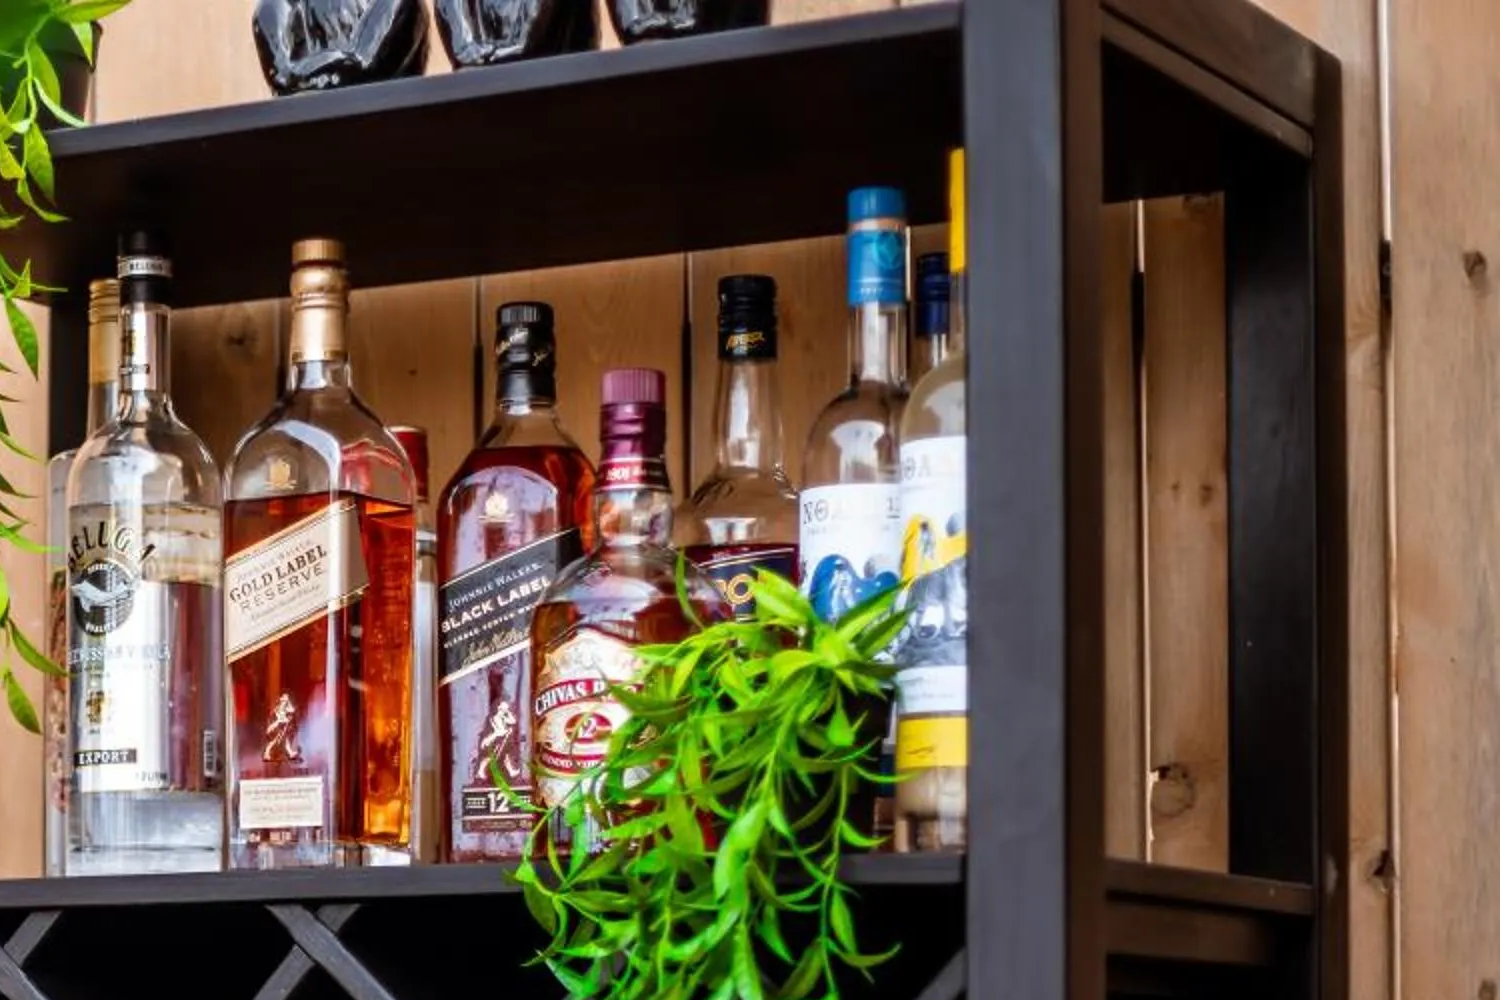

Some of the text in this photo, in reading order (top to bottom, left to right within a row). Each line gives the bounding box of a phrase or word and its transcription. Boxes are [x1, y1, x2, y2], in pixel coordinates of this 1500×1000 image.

[229, 571, 273, 603] GOLD
[275, 544, 327, 581] LABEL
[240, 562, 323, 612] RESERVE
[441, 574, 552, 633] BLACK LABEL
[535, 681, 588, 715] CHIVAS
[78, 751, 129, 765] EXPORT
[488, 791, 510, 813] 12
